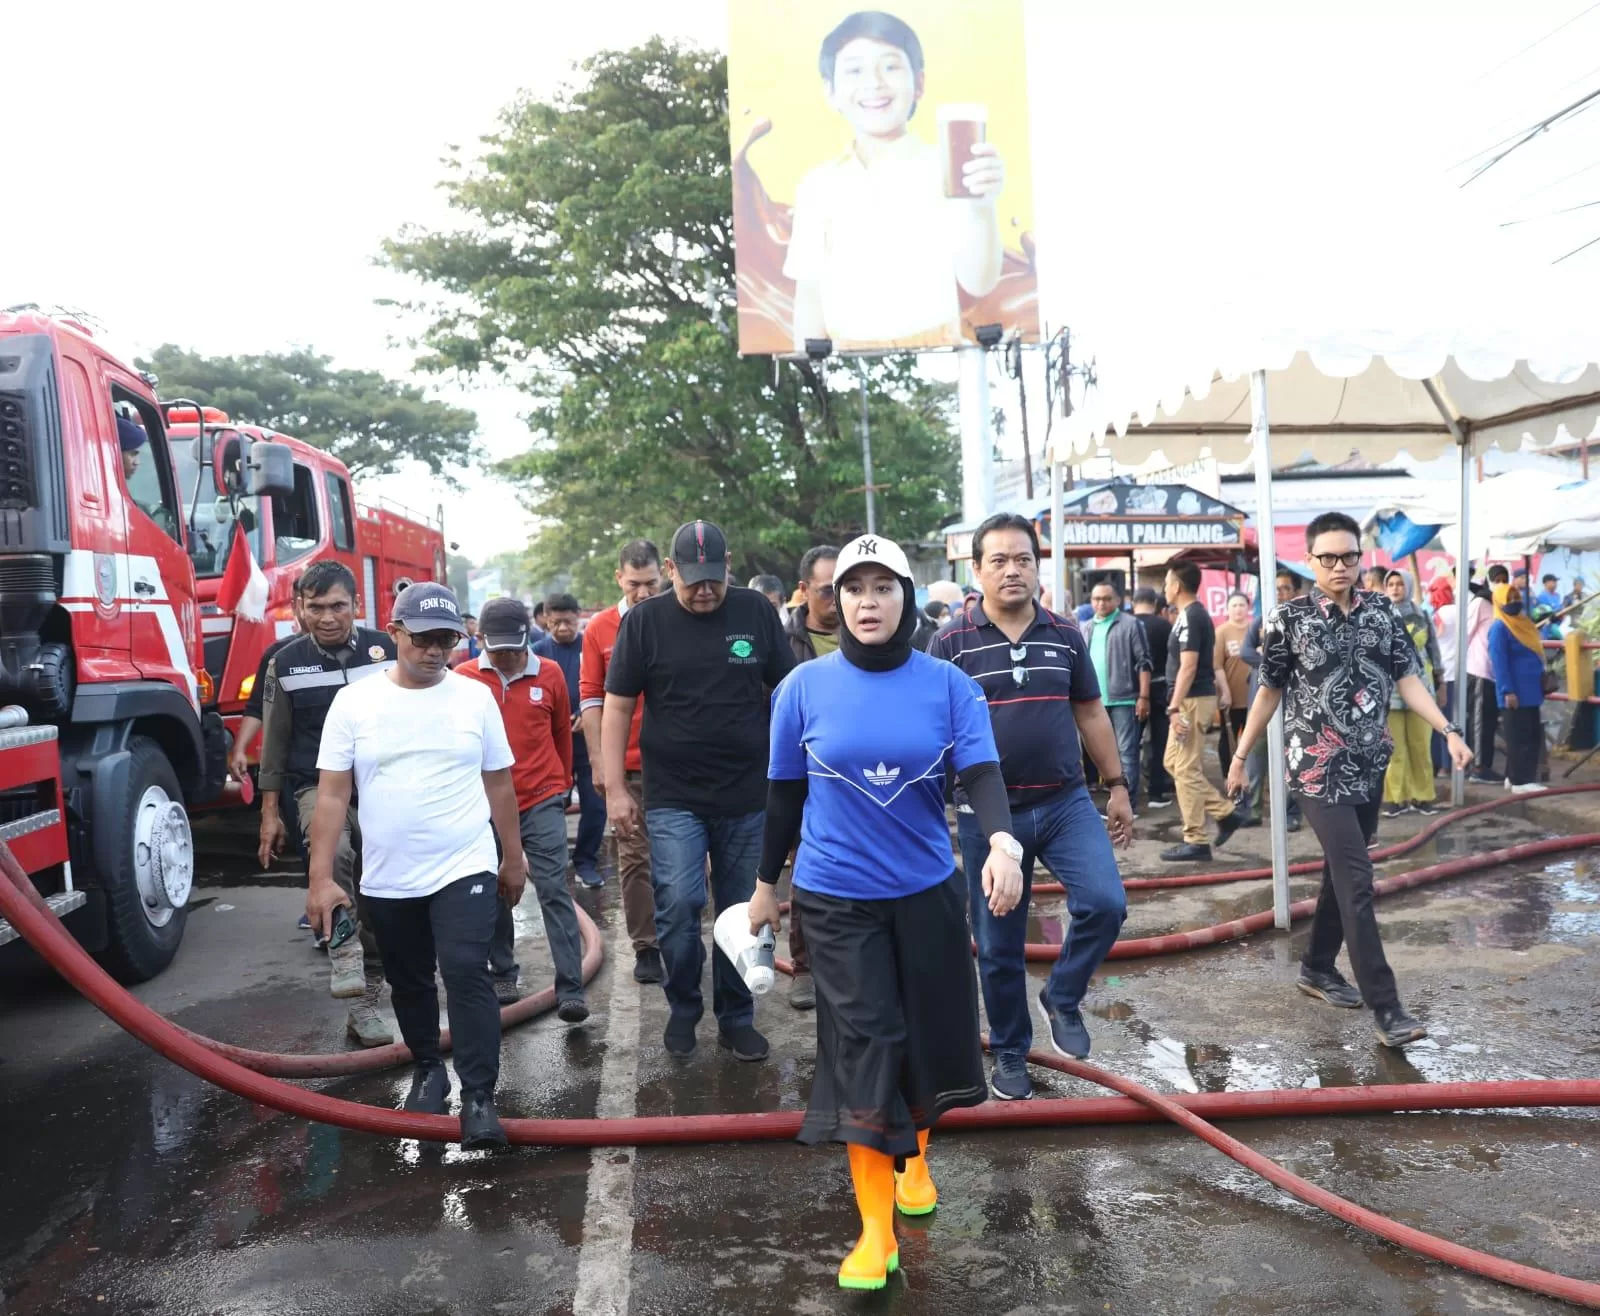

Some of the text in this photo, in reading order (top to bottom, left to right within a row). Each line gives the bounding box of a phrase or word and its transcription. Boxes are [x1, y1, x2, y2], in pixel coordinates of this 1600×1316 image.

[1064, 524, 1224, 544] AROMA PALADANG
[858, 539, 877, 555] NY
[420, 597, 458, 616] PENN STATE
